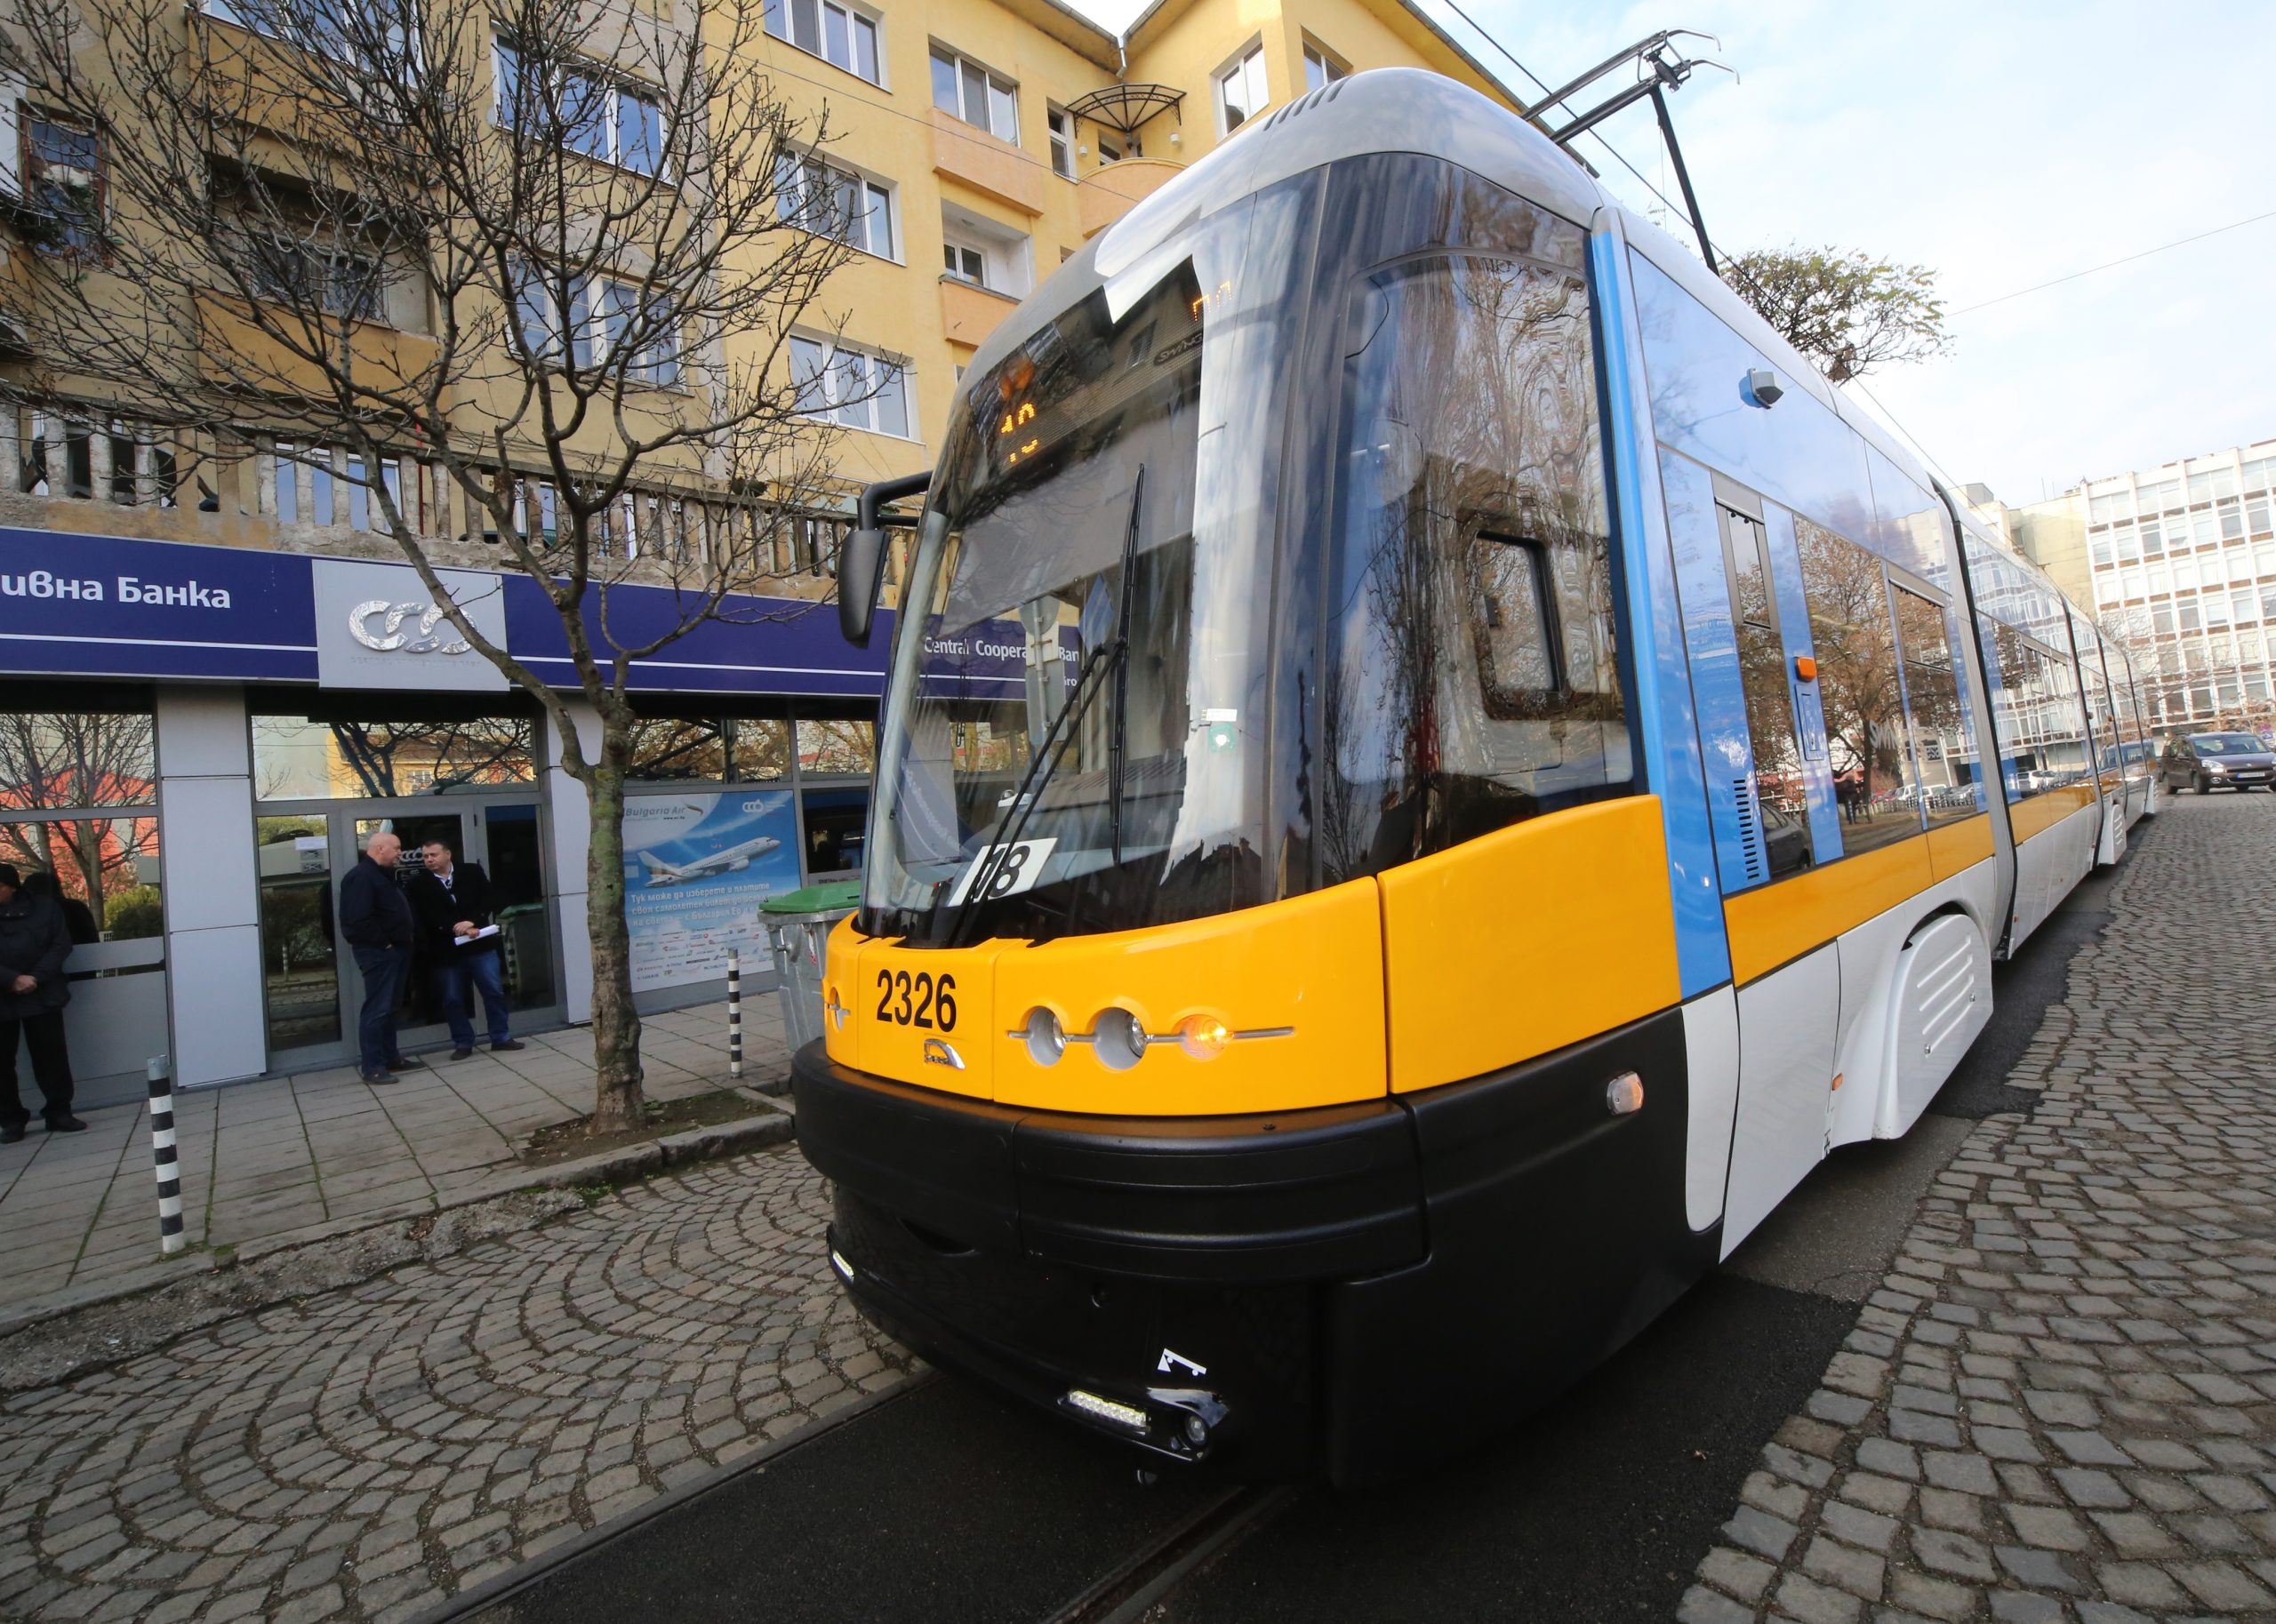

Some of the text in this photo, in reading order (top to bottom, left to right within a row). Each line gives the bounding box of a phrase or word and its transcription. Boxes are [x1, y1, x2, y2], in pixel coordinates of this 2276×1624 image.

[1, 570, 231, 609] ивна Банка
[924, 636, 970, 655] Central
[626, 806, 685, 818] Bulgaria Air
[969, 845, 1031, 900] 18
[877, 969, 957, 1033] 2326
